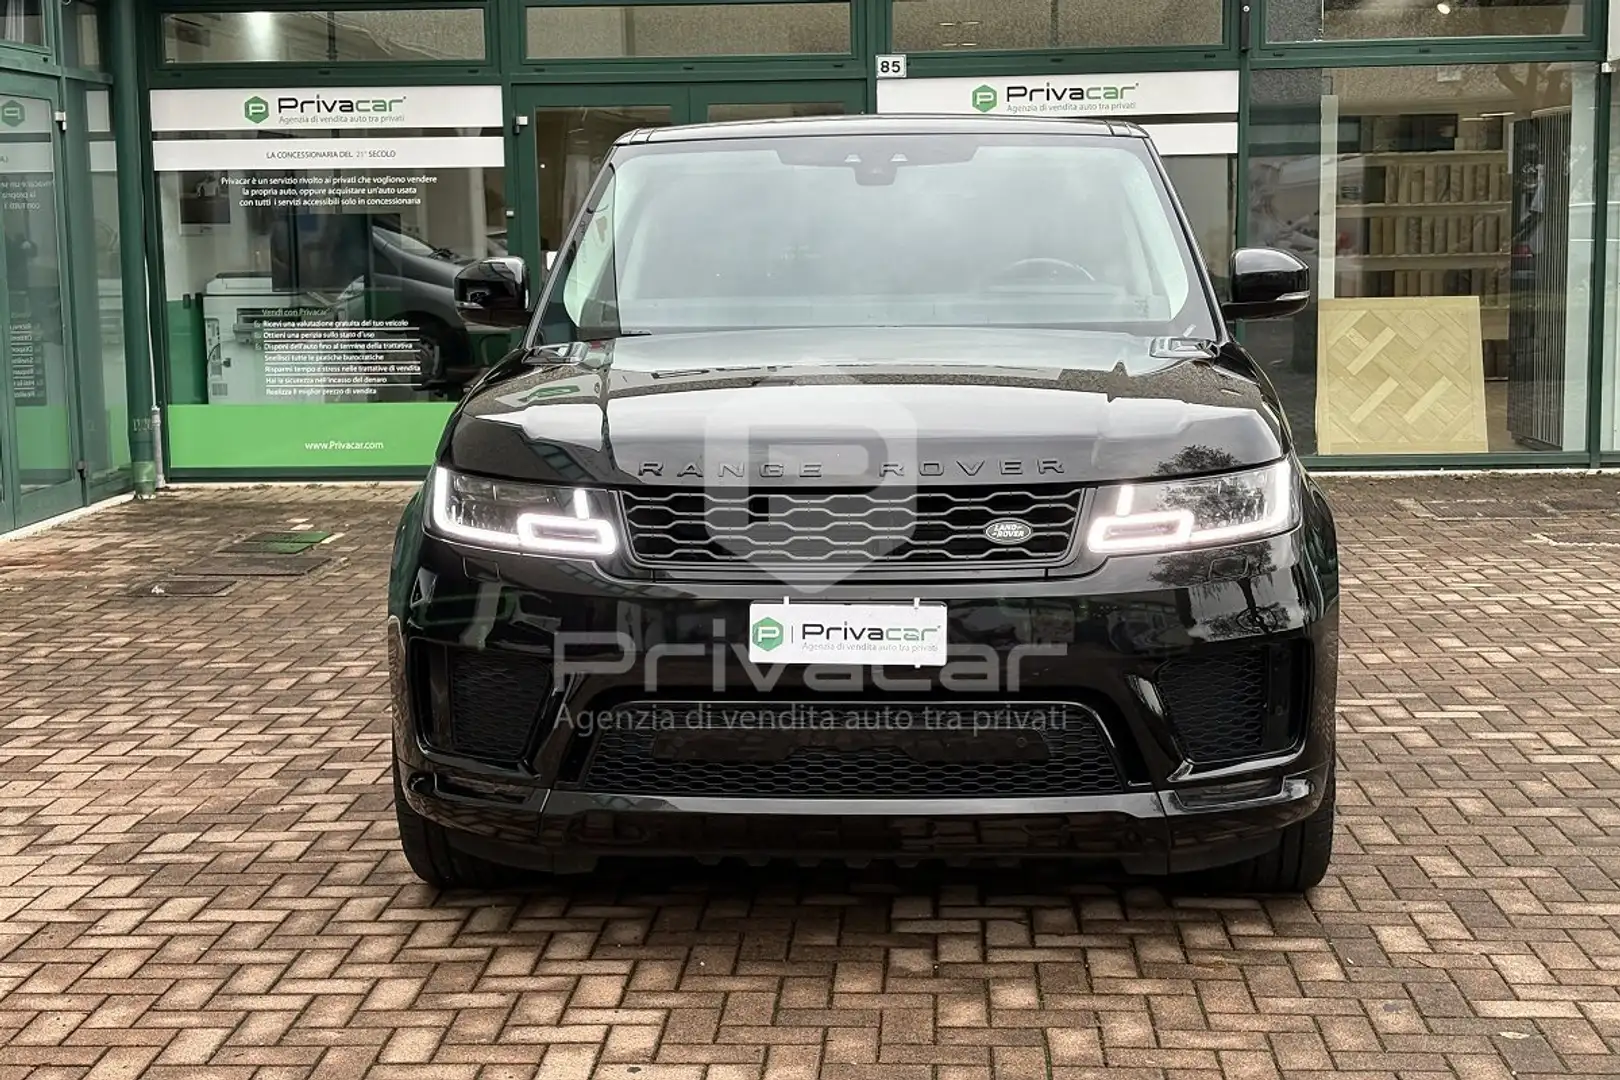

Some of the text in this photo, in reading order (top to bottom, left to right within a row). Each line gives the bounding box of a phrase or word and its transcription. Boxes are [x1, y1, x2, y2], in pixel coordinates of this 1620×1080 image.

[880, 60, 901, 73] 85
[1007, 82, 1137, 102] Privacar
[278, 94, 403, 114] Privacar
[1007, 102, 1136, 114] Agenzia di vendita auto tra privati
[279, 115, 309, 124] Agenzia
[310, 115, 318, 123] di
[319, 115, 348, 123] vendita
[349, 115, 367, 123] auto
[380, 115, 405, 123] privati
[266, 151, 276, 159] LA
[277, 150, 338, 159] CONCESSIONARIA
[368, 150, 396, 158] SECOLO
[221, 177, 251, 185] Privacar
[269, 177, 298, 185] servizio
[299, 176, 323, 184] rivolto
[332, 176, 356, 186] privati
[357, 176, 372, 184] che
[372, 175, 406, 185] vogliono
[407, 174, 437, 183] vendere
[242, 187, 250, 195] la
[251, 188, 278, 197] propria
[328, 187, 366, 196] acquistare
[278, 198, 301, 206] servizi
[302, 197, 340, 206] accessibili
[341, 197, 357, 205] solo
[366, 197, 421, 205] concessionaria
[262, 308, 283, 316] Vendi
[334, 320, 360, 328] gratuita
[263, 331, 286, 339] Ottieni
[300, 332, 323, 340] perizia
[264, 343, 290, 351] Disponi
[315, 354, 342, 362] pratiche
[294, 366, 316, 374] tempo
[298, 388, 321, 396] miglior
[322, 388, 344, 396] prezzo
[304, 440, 384, 450] www.Privacar.com
[637, 459, 1065, 478] RANGE ROVER
[802, 621, 938, 642] Privacar
[802, 642, 939, 653] Agenzia di vendita auto tra privati
